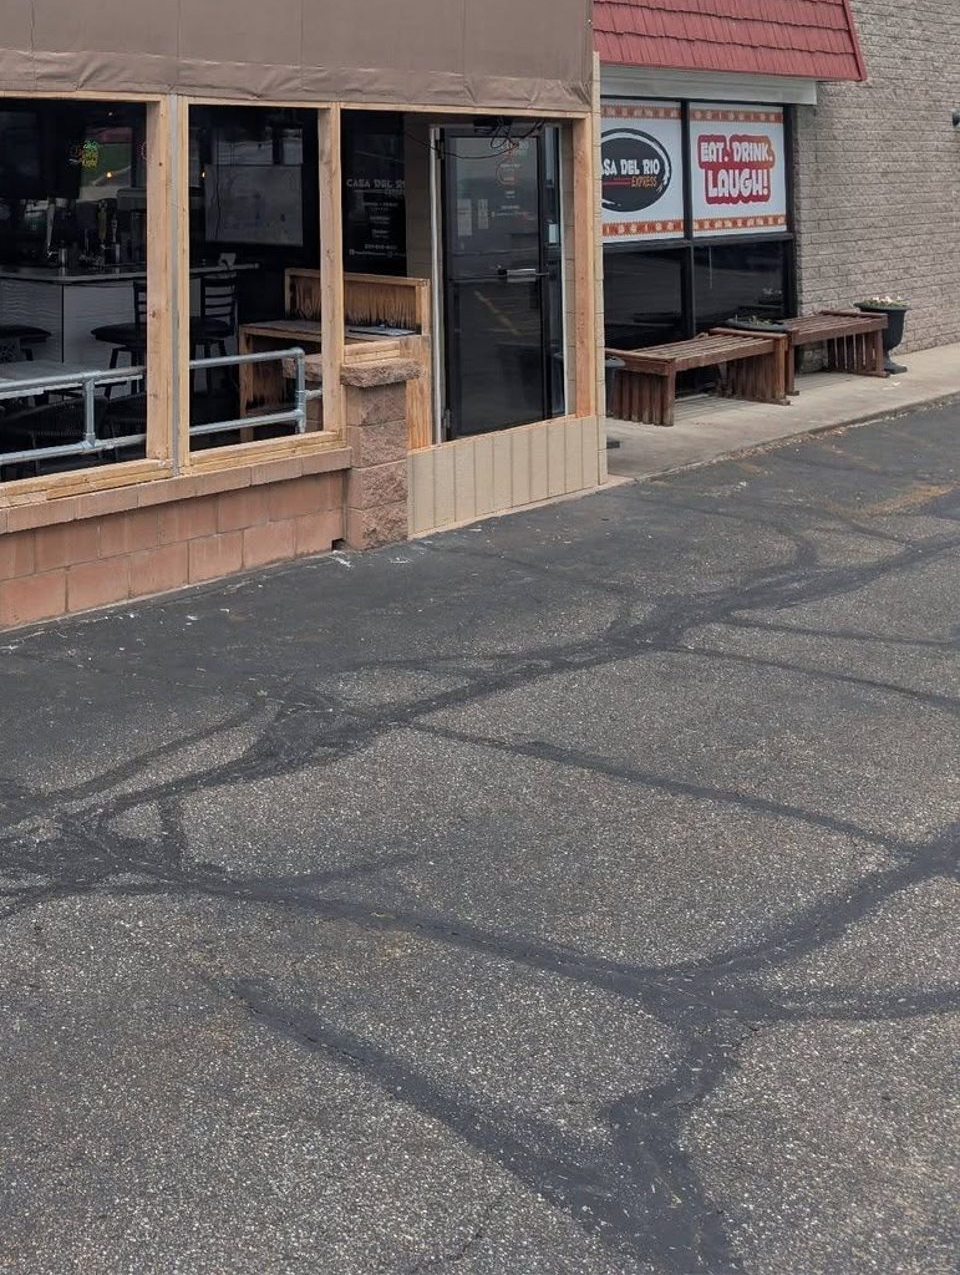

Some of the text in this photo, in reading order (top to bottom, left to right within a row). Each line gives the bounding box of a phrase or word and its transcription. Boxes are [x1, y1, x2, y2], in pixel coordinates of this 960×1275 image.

[700, 141, 774, 162] EAT. DRINK.
[601, 158, 661, 175] SA DEL RIO
[631, 176, 657, 187] EXPRESS
[707, 168, 769, 198] LAUGH!
